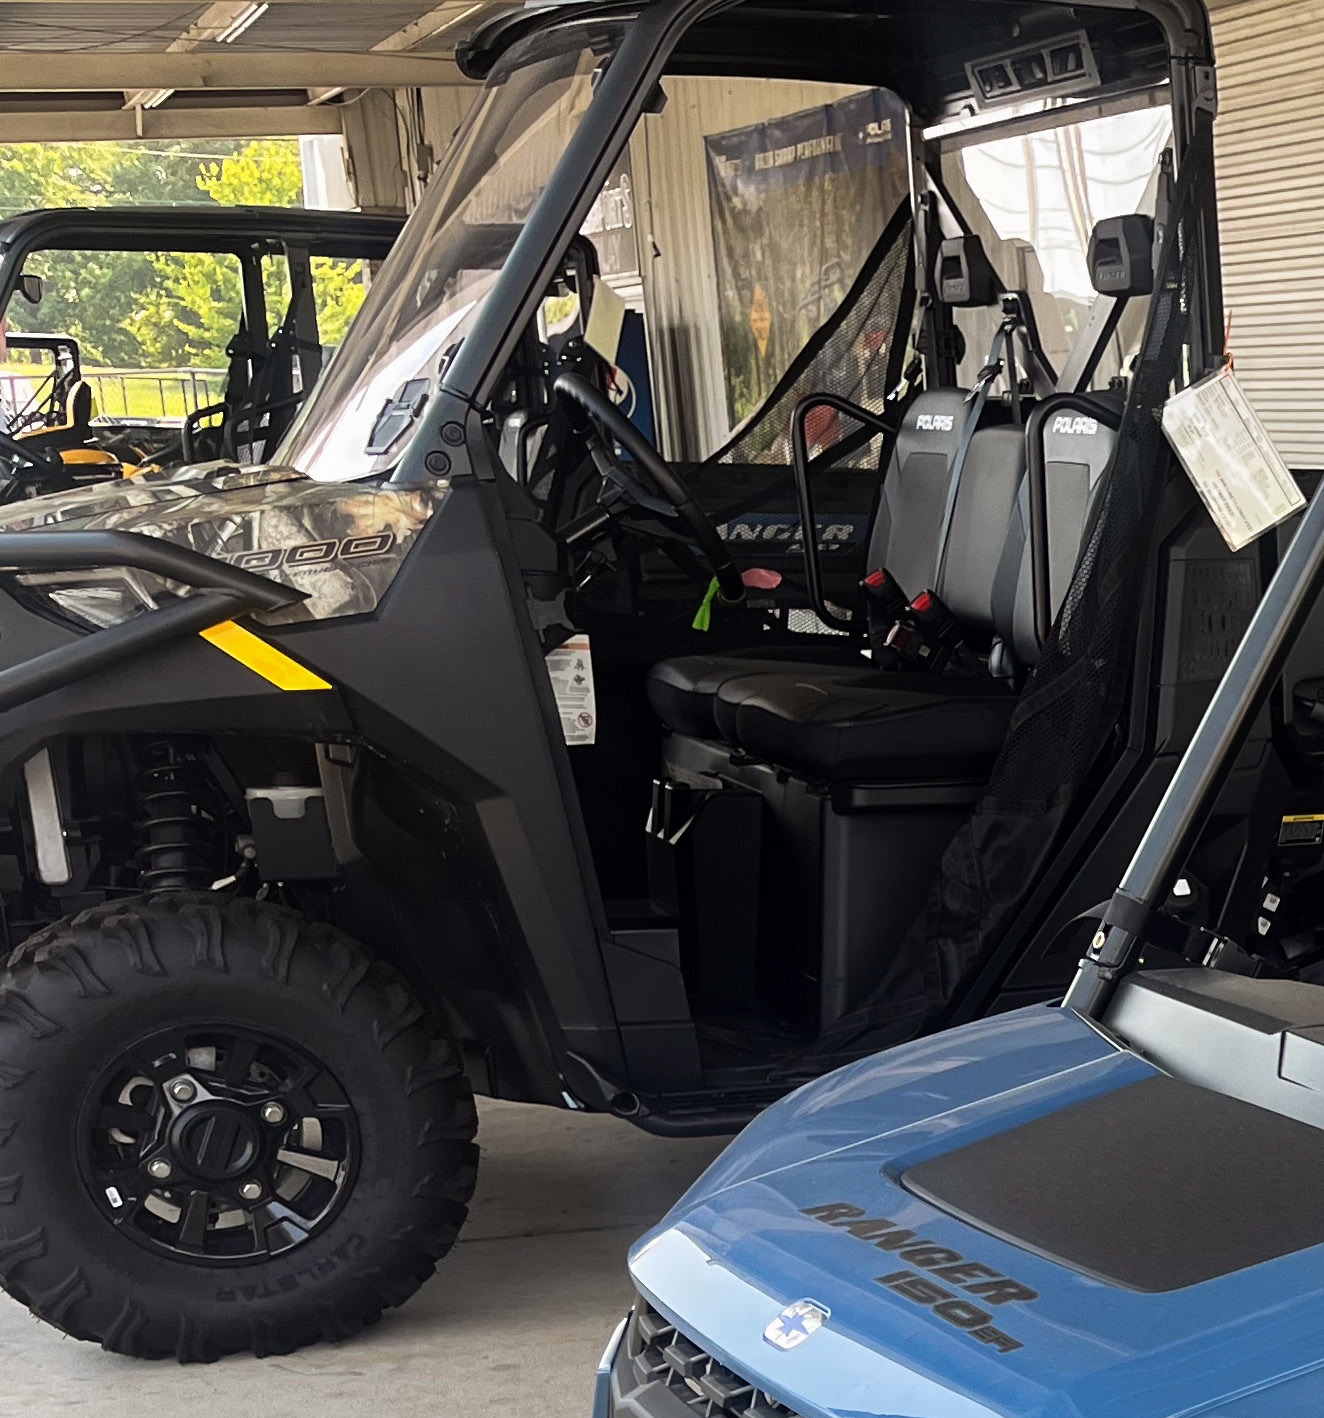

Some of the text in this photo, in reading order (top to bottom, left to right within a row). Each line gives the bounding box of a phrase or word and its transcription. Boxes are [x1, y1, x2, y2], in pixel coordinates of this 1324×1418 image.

[916, 414, 954, 431] POLARIS
[1052, 416, 1098, 435] POLARIS
[213, 531, 395, 572] 000
[799, 1202, 1040, 1306] RANGER
[872, 1270, 993, 1329] 150
